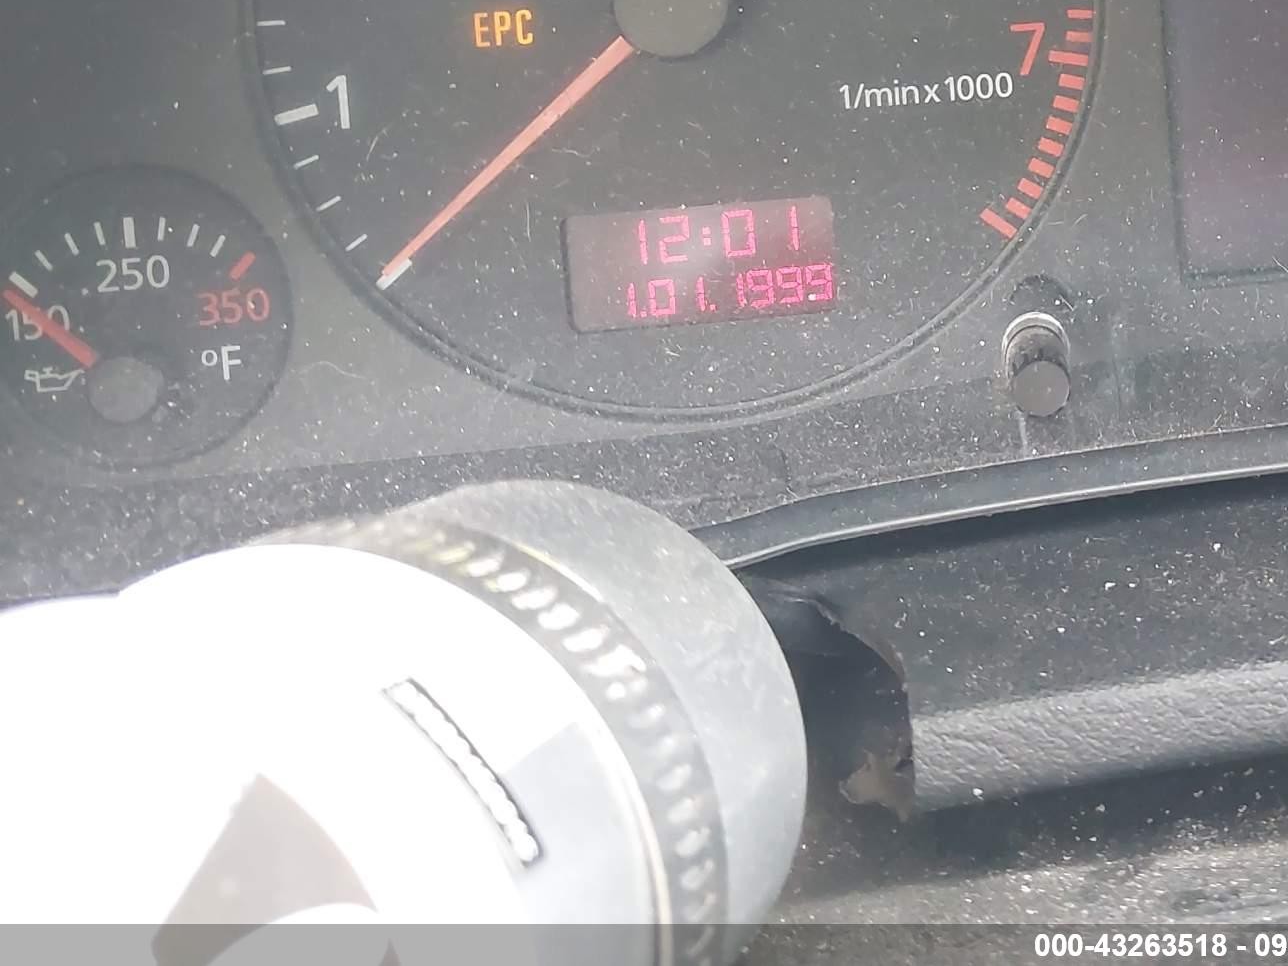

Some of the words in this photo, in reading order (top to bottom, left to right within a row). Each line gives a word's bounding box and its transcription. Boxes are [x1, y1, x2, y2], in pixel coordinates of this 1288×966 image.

[473, 8, 534, 48] EPC
[1010, 22, 1046, 77] 7
[326, 75, 351, 129] 1
[638, 205, 800, 265] 12:01
[96, 255, 170, 293] 250
[199, 288, 271, 326] 350
